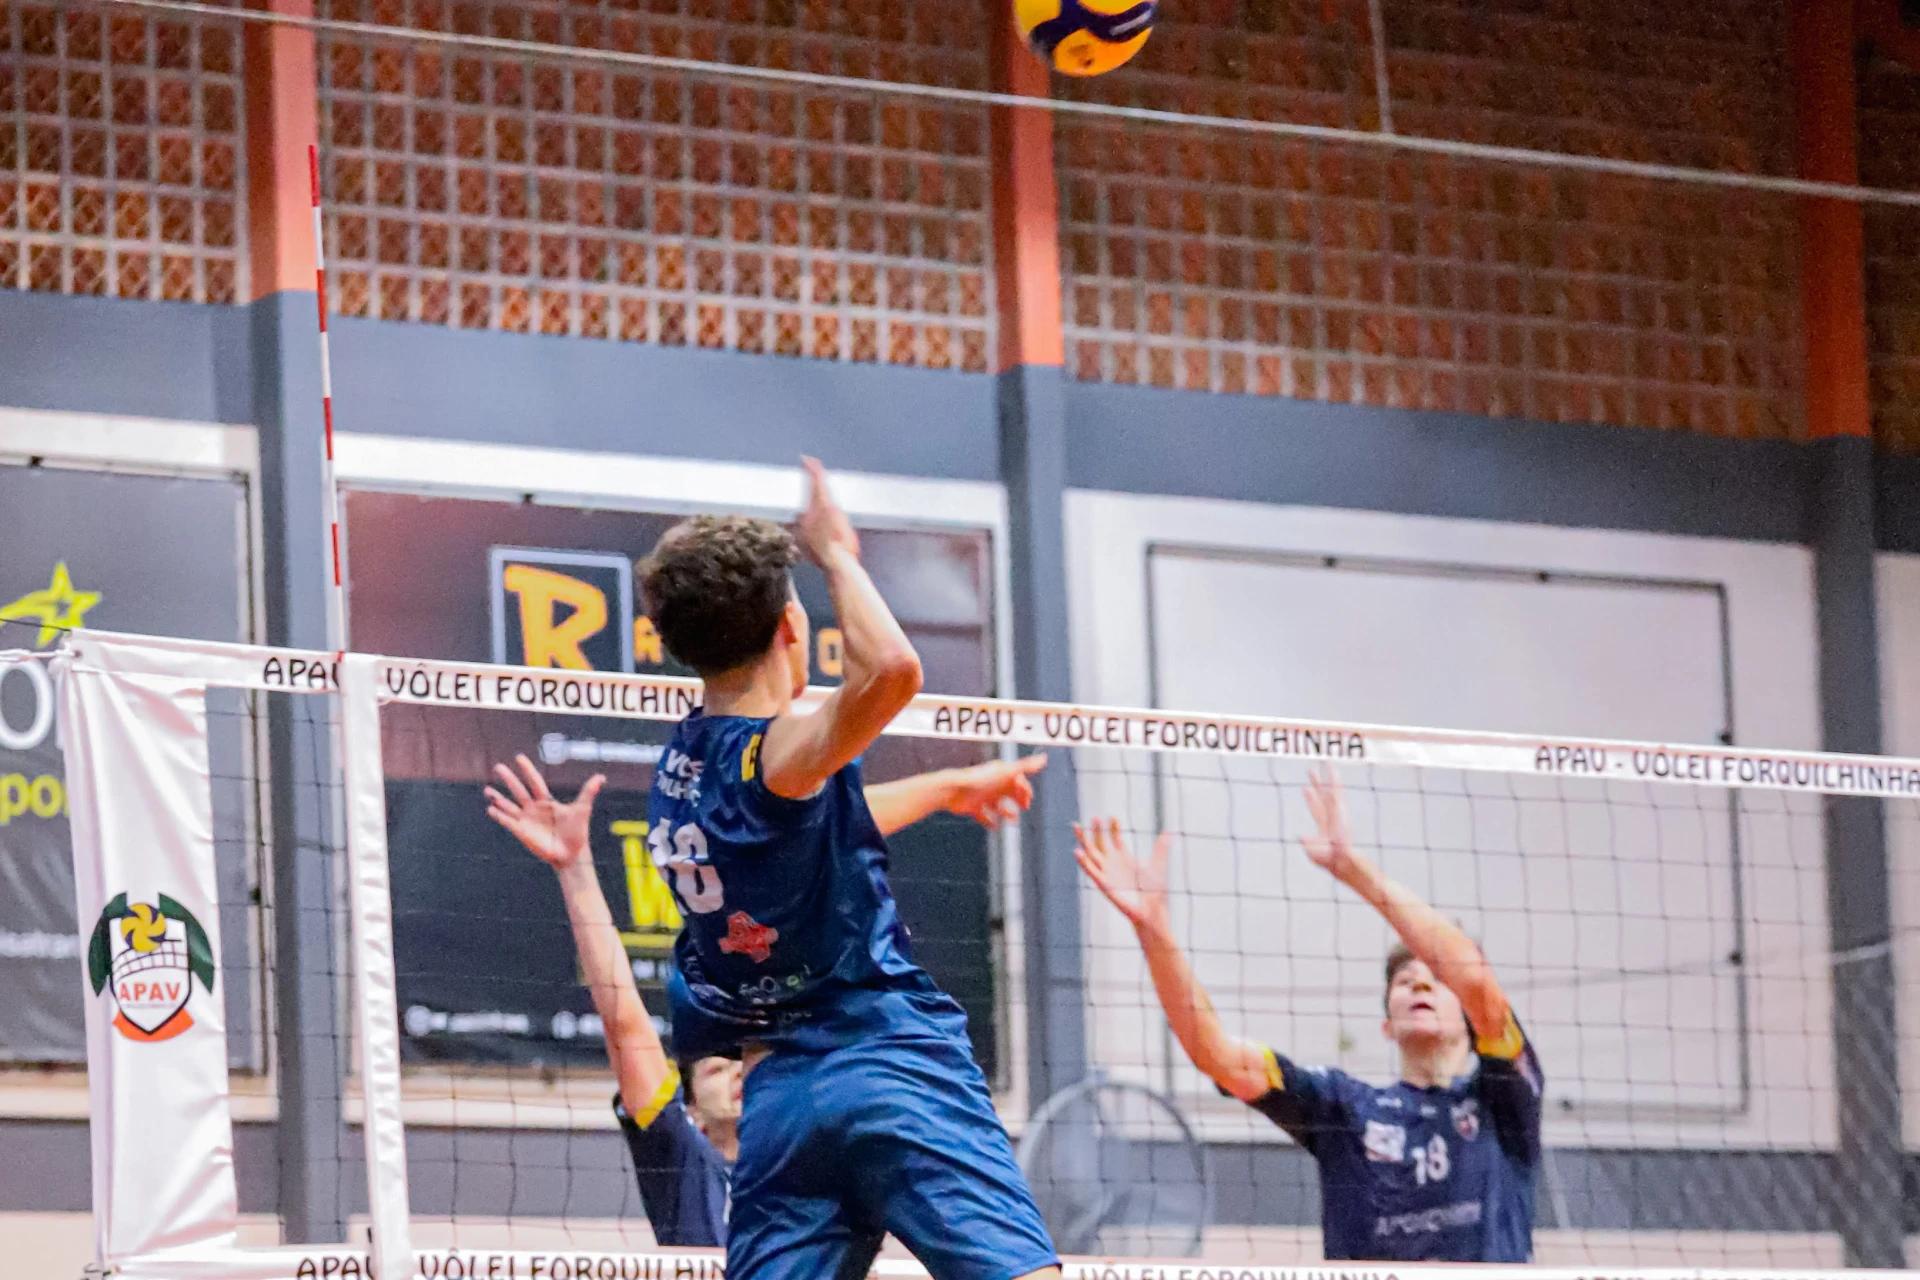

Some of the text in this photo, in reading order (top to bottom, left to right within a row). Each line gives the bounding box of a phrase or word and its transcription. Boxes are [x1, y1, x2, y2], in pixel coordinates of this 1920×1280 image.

[387, 662, 481, 702] VÔLEI
[935, 705, 1014, 736] APAV
[1143, 718, 1365, 758] FORQUILHINHA
[1534, 744, 1606, 773] APAV
[1722, 756, 1920, 794] FORQUILHINHA
[119, 981, 181, 1002] APAV
